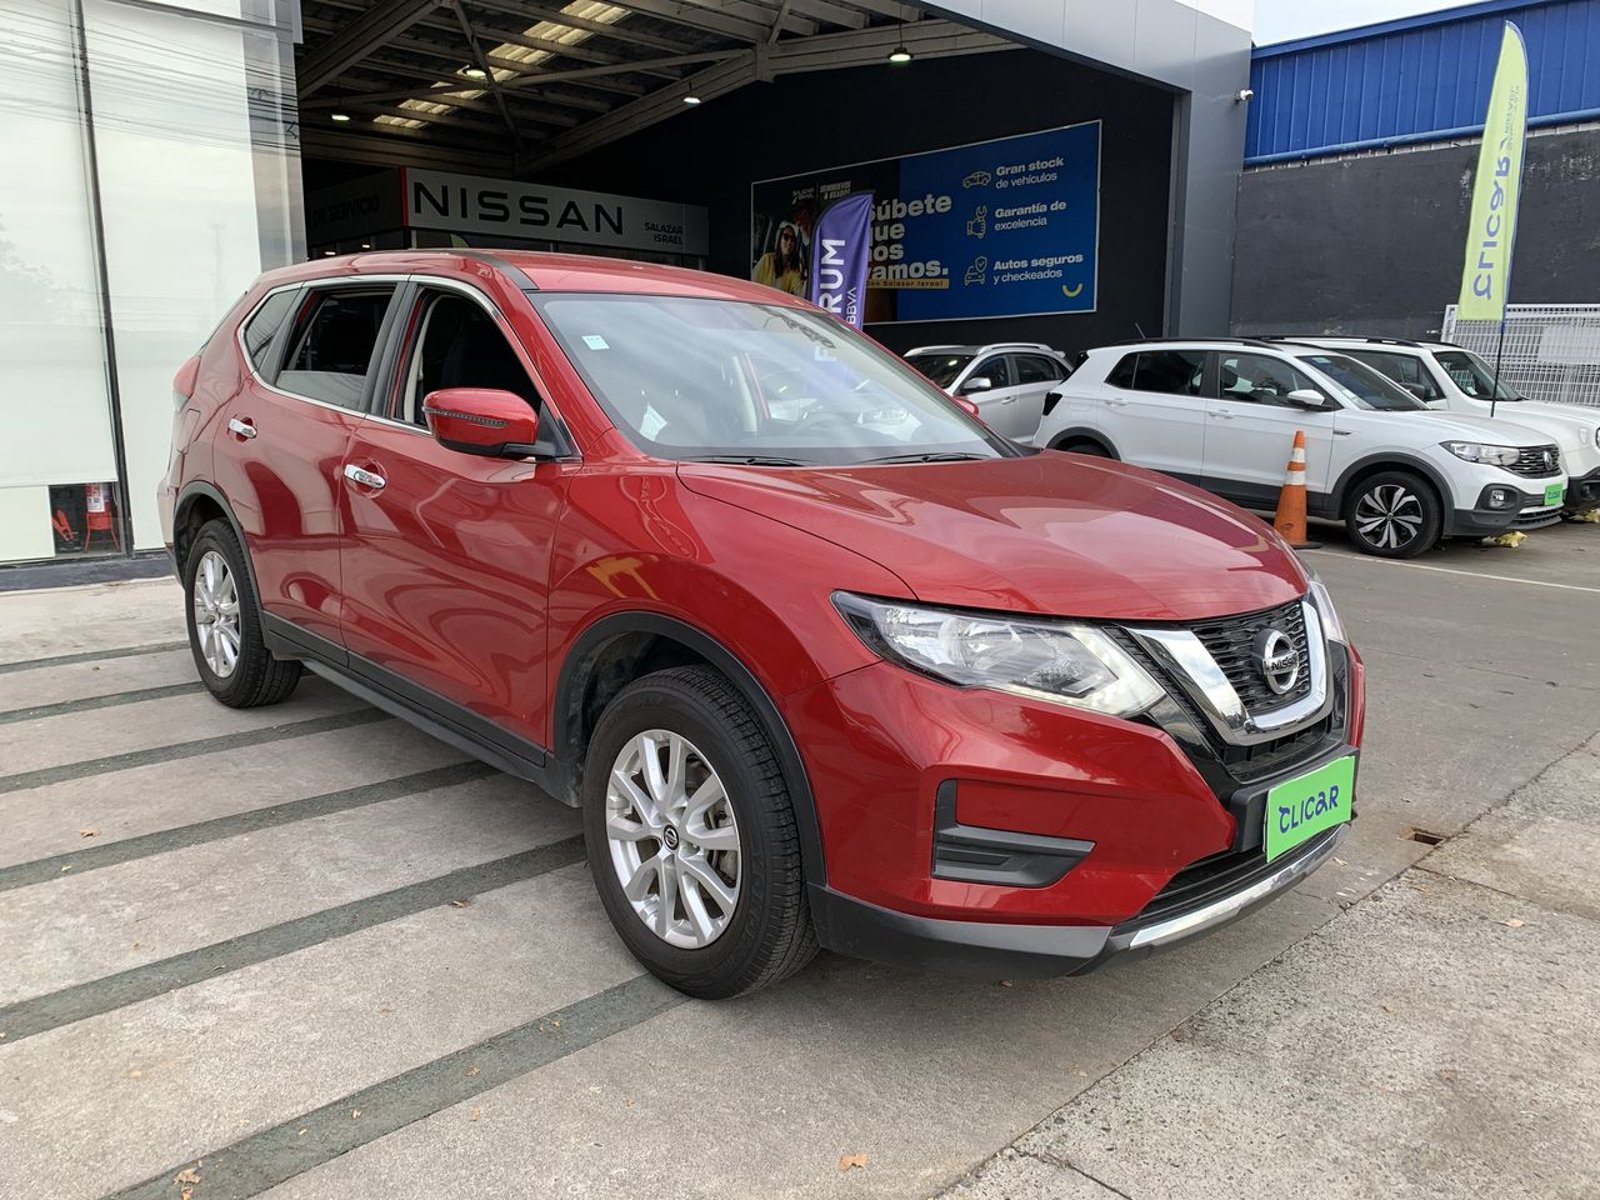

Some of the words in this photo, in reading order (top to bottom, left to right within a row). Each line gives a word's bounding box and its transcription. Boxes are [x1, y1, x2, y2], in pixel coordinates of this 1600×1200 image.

[996, 164, 1026, 176] Gran
[1028, 156, 1064, 172] stock
[995, 178, 1009, 189] de
[1010, 172, 1058, 187] vehículos
[413, 181, 623, 236] NISSAN
[995, 202, 1047, 218] Garantía
[1050, 200, 1067, 211] de
[644, 221, 684, 234] SALAZAR
[995, 216, 1047, 231] excelencia
[654, 233, 684, 245] ISRAEL
[869, 222, 906, 246] ue
[867, 259, 949, 280] amos.
[993, 259, 1028, 271] Autos
[1030, 254, 1084, 268] seguros
[993, 274, 1000, 285] y
[1001, 269, 1062, 283] checkeados
[845, 286, 858, 325] BBVA
